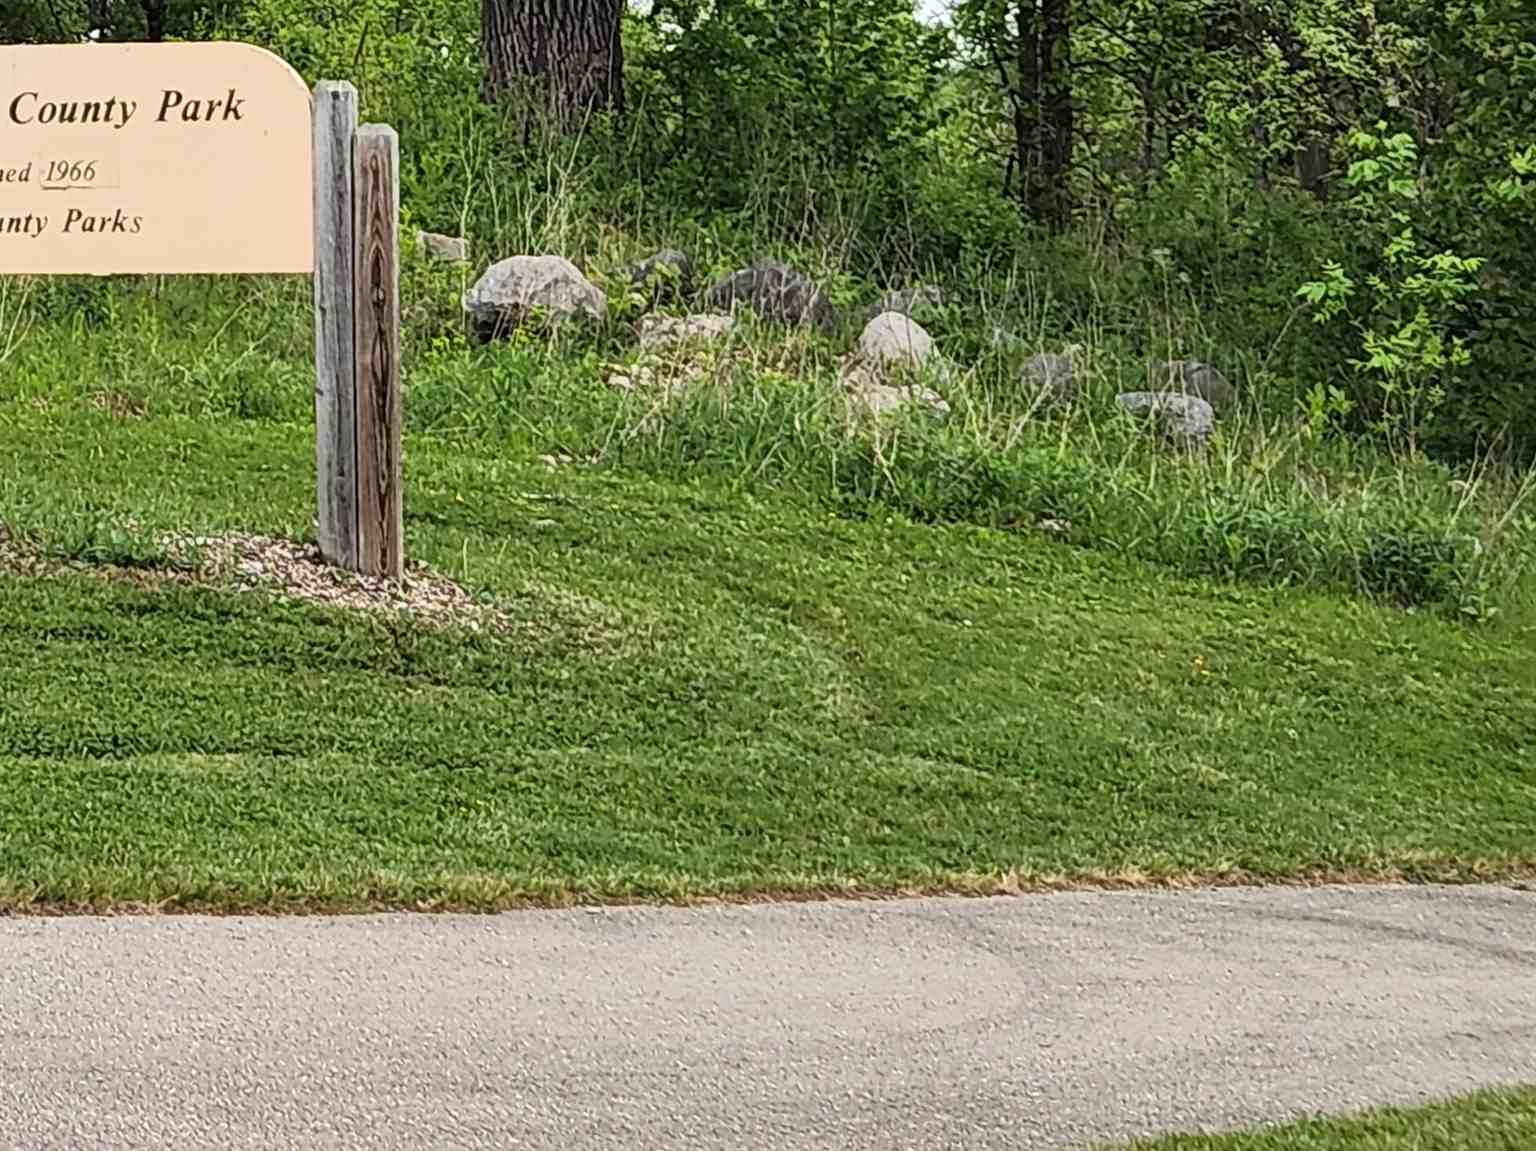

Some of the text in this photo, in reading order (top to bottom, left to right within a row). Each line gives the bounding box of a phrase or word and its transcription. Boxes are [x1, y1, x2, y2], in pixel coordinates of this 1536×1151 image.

[8, 92, 137, 130] County
[155, 88, 245, 122] Park
[46, 161, 97, 182] 1966
[62, 208, 143, 233] Parks
